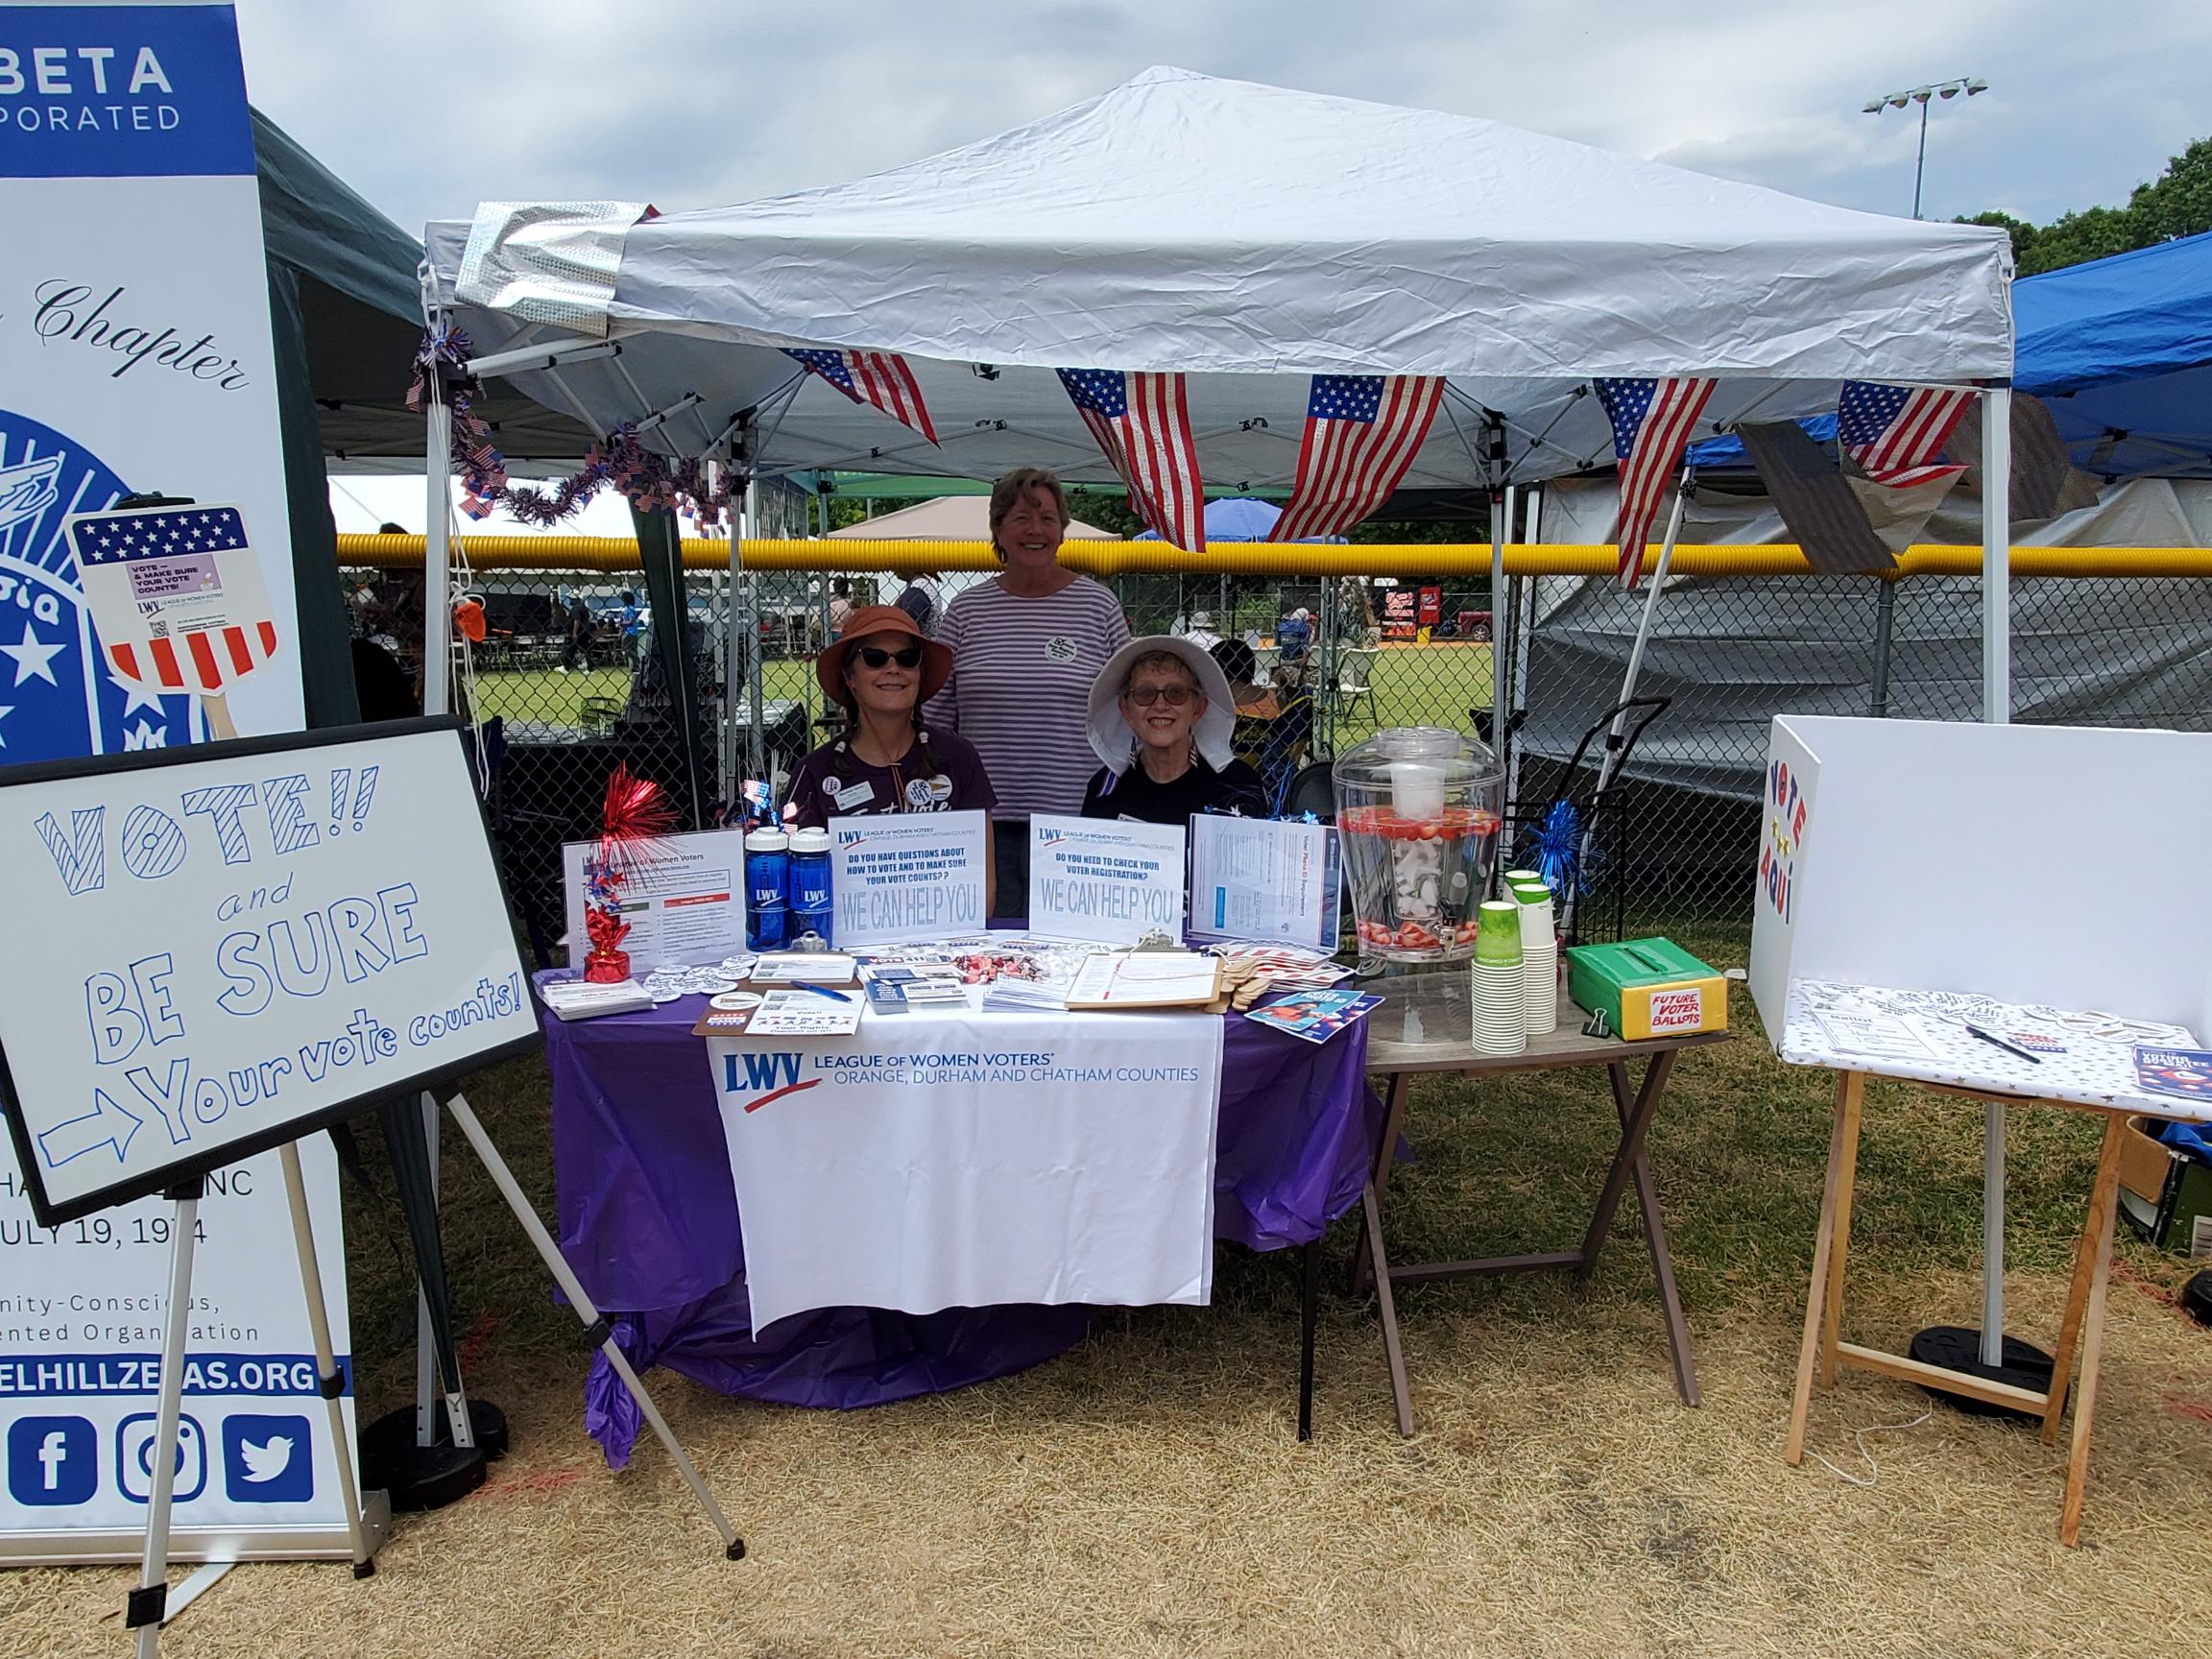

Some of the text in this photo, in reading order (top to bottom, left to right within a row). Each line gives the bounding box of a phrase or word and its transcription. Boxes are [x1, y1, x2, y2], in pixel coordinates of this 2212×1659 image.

[35, 278, 252, 389] Chapter
[137, 584, 179, 593] COUNTS!
[137, 600, 159, 613] LWV
[1770, 759, 1807, 852] VOTE
[34, 766, 379, 895] VOTE!!
[838, 830, 861, 844] LWV
[1039, 828, 1061, 840] LWV
[650, 855, 678, 865] Women
[681, 854, 704, 862] Voters
[849, 848, 965, 863] DO YOU HAVE QUESTIONS ABOUT
[1068, 854, 1082, 863] YOU
[1084, 855, 1101, 865] NEED
[1103, 857, 1112, 866] TO
[1114, 858, 1138, 868] CHECK
[1140, 860, 1160, 871] YOUR
[878, 864, 897, 873] VOTE
[899, 863, 913, 872] AND
[916, 862, 925, 871] TO
[926, 860, 947, 869] MAKE
[949, 858, 967, 868] SURE
[1067, 865, 1148, 880] VOTER REGISTRATION?
[866, 876, 886, 885] YOUR
[888, 876, 906, 884] VOTE
[217, 871, 294, 921] and
[756, 889, 778, 901] LWV
[805, 890, 825, 902] LWV
[1041, 878, 1173, 924] WE CAN HELP YOU
[843, 883, 976, 931] WE CAN HELP YOU
[84, 882, 428, 1065] BE SURE
[1652, 993, 1697, 1005] FUTURE
[1658, 1002, 1699, 1015] VOTER
[1651, 1014, 1699, 1026] BALLOTS
[125, 972, 520, 1143] Your vote counts!
[723, 1052, 1053, 1092] LWV LEAGUE OF WOMEN VOTERS
[834, 1068, 1198, 1085] ORANGE, DURHAM AND CHATHAM COUNTIES
[204, 1170, 252, 1196] NC
[74, 1218, 122, 1249] 19,
[132, 1218, 207, 1244] 194
[84, 1323, 258, 1344] Organation
[0, 1362, 315, 1391] ELHILLZEAS.ORG
